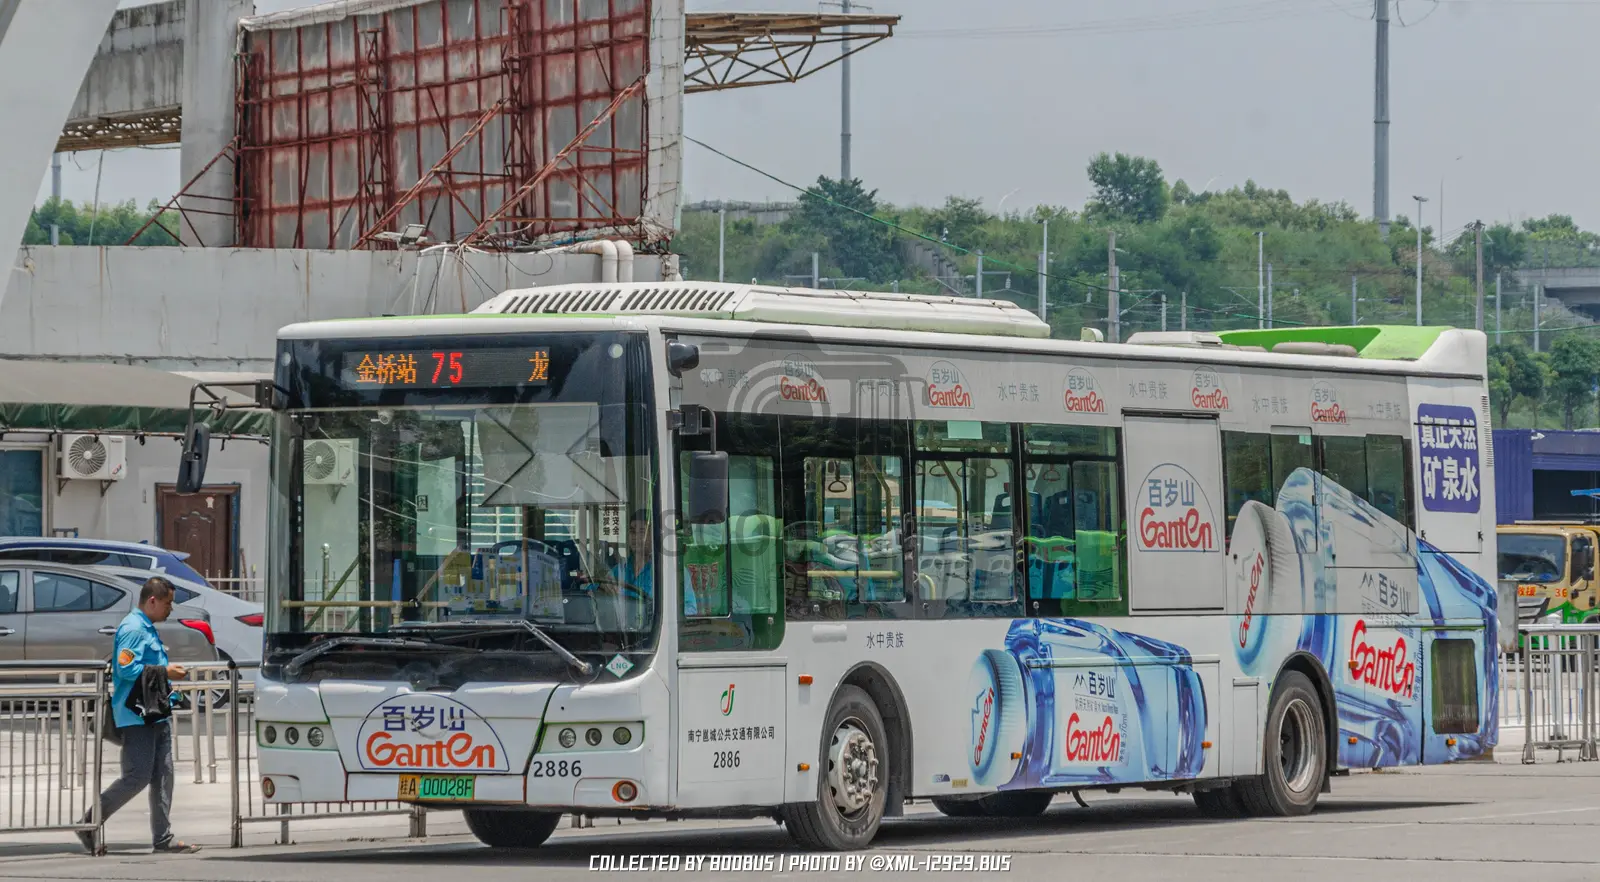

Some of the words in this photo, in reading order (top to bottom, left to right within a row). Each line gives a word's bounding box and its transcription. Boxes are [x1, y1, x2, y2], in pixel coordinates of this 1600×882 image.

[356, 353, 418, 384] 金桥站
[431, 352, 463, 384] 75
[528, 351, 550, 382] 龙
[784, 360, 814, 378] 百岁山
[932, 368, 960, 385] 百岁山
[1068, 375, 1095, 391] 百岁山
[1128, 380, 1168, 400] 水中贵族
[1195, 373, 1218, 388] 百岁山
[997, 383, 1040, 402] 水中贵族
[1313, 388, 1337, 403] 百岁山
[1252, 396, 1289, 415] 水中贵族
[1420, 414, 1478, 450] 真正天然
[1422, 455, 1479, 501] 矿泉水
[1148, 478, 1195, 507] 百岁山
[1378, 572, 1411, 617] 百岁山
[866, 631, 905, 649] 水中贵族
[610, 662, 628, 670] LNG
[1088, 671, 1116, 698] 百岁山
[382, 705, 465, 732] 百岁山
[687, 726, 775, 743] 南宁邕城公共交通有限公司
[533, 760, 582, 778] 2886
[713, 750, 741, 769] 2886
[423, 778, 473, 796] 00028F
